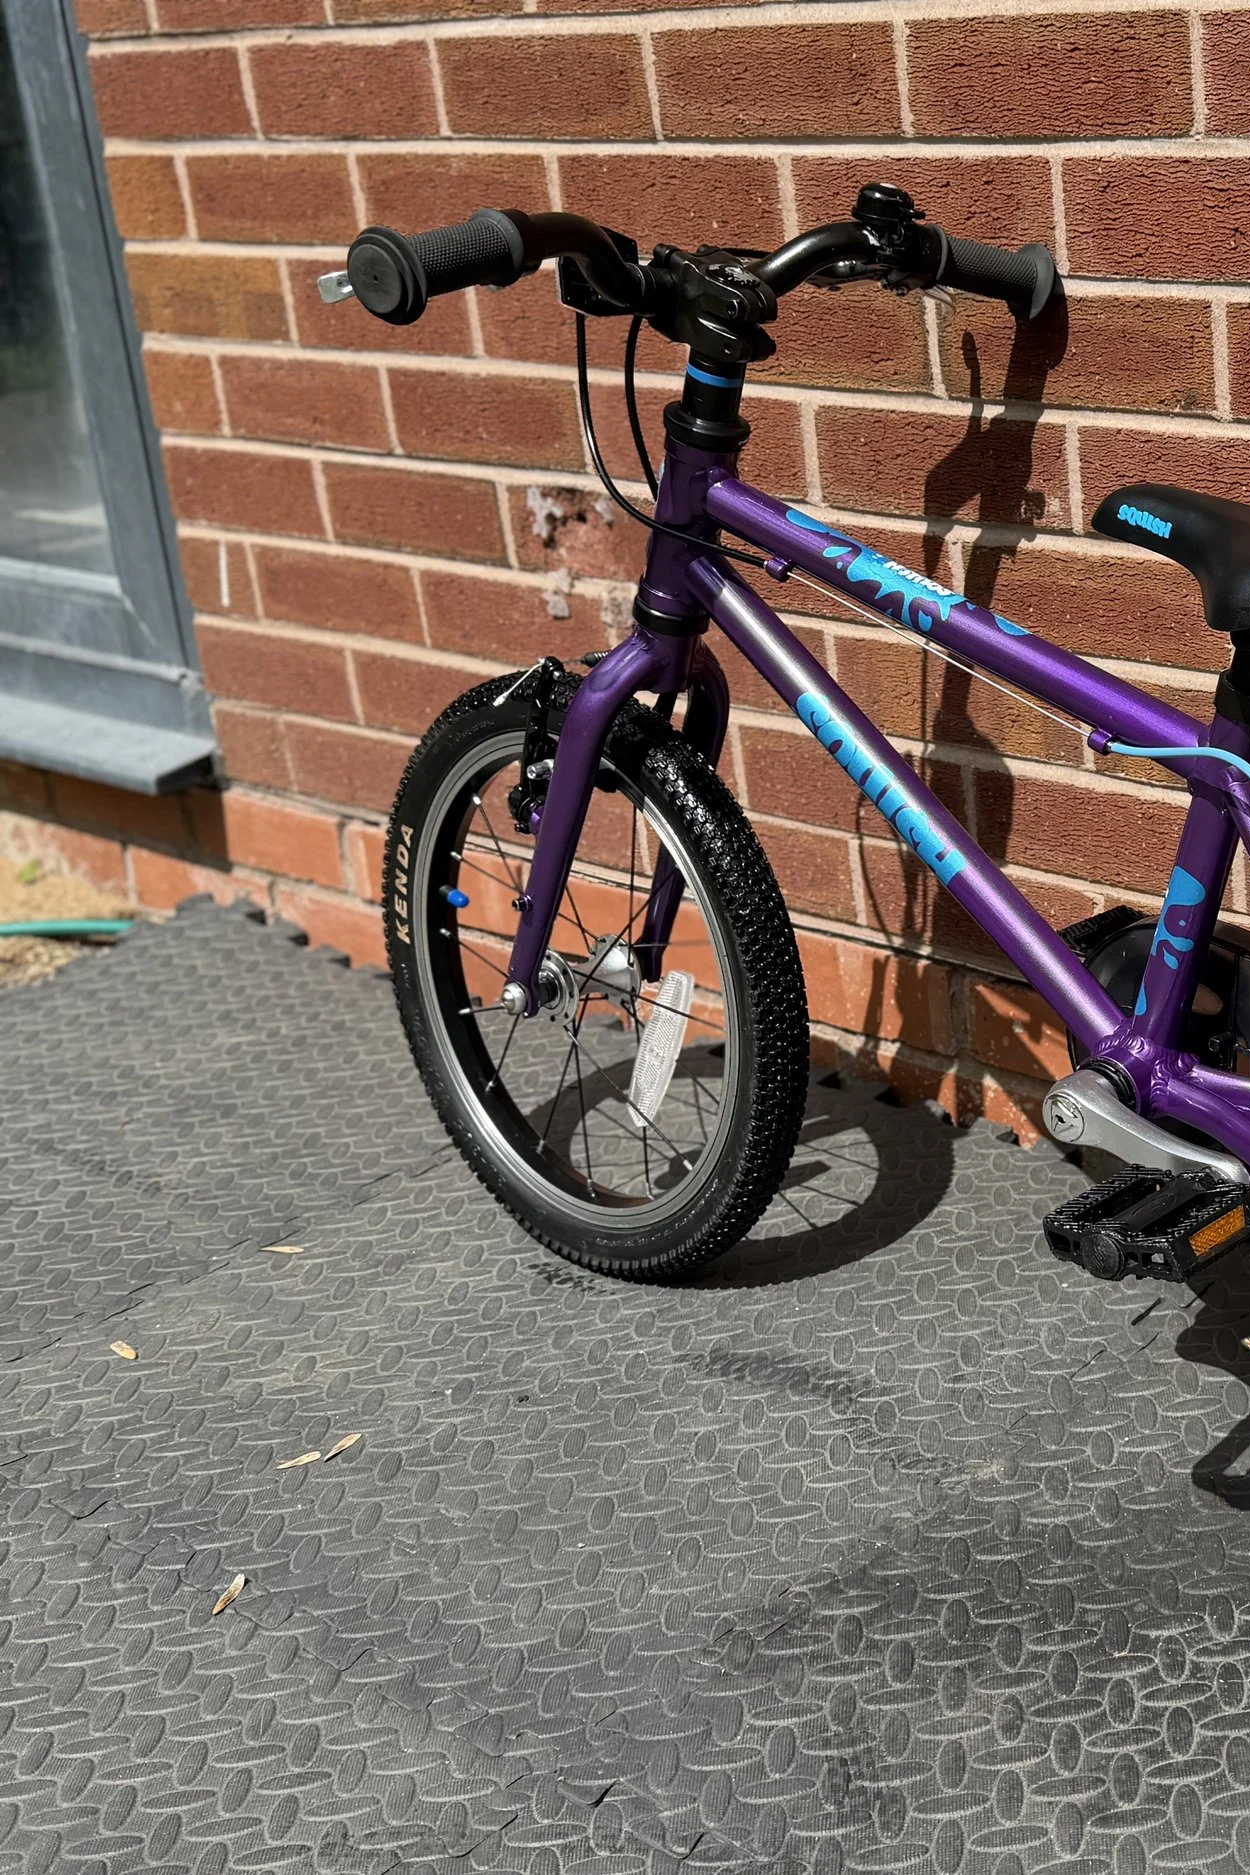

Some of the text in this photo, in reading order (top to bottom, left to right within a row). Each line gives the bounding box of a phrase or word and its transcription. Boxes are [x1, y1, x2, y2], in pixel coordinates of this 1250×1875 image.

[1117, 504, 1173, 539] SQUISH
[796, 691, 968, 885] SQUISH
[395, 824, 414, 945] KENDA
